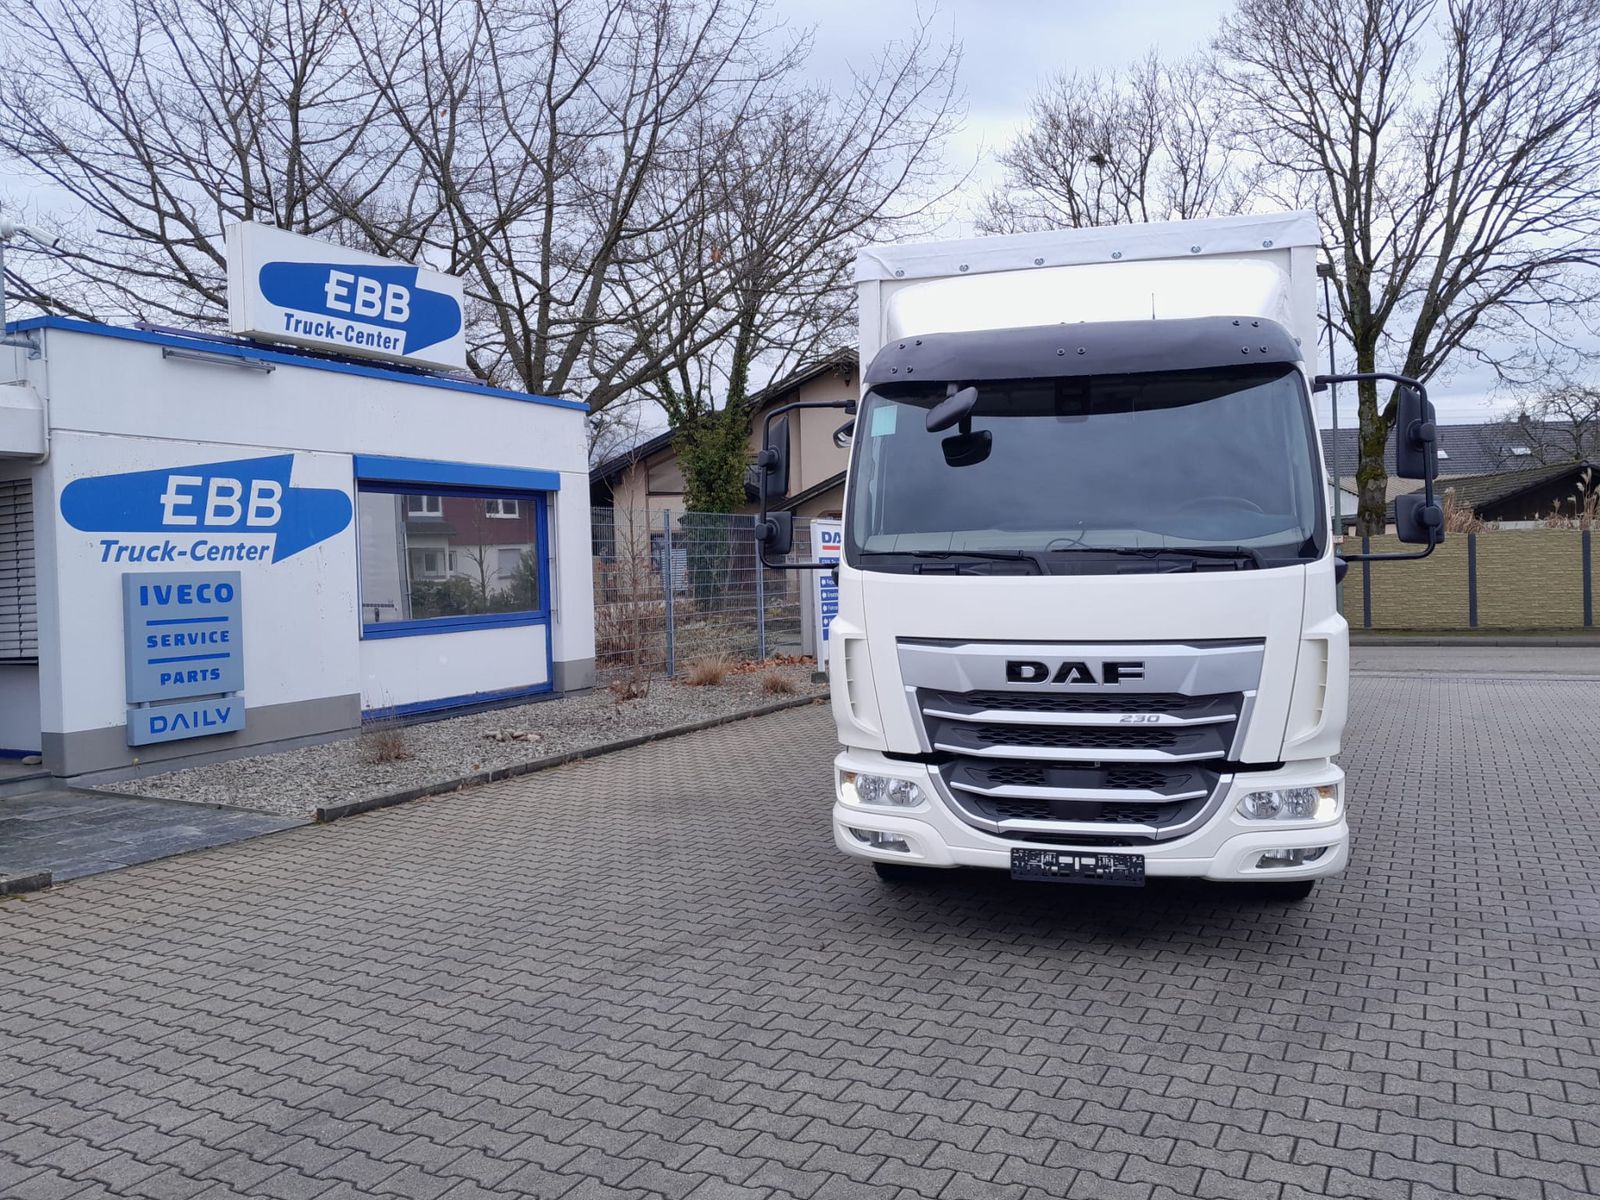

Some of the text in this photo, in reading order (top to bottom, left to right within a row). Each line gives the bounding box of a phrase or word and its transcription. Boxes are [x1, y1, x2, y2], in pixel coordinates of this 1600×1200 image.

[325, 269, 411, 323] EBB
[284, 312, 400, 350] Truck-Center
[160, 475, 282, 527] EBB
[821, 531, 841, 544] DA
[99, 540, 269, 562] Truck-Center
[140, 583, 233, 606] IVECO
[147, 630, 230, 648] SERVICE
[160, 668, 220, 686] PARTS
[1006, 660, 1145, 686] DAF
[150, 707, 231, 734] DAILY
[1119, 714, 1160, 723] 230
